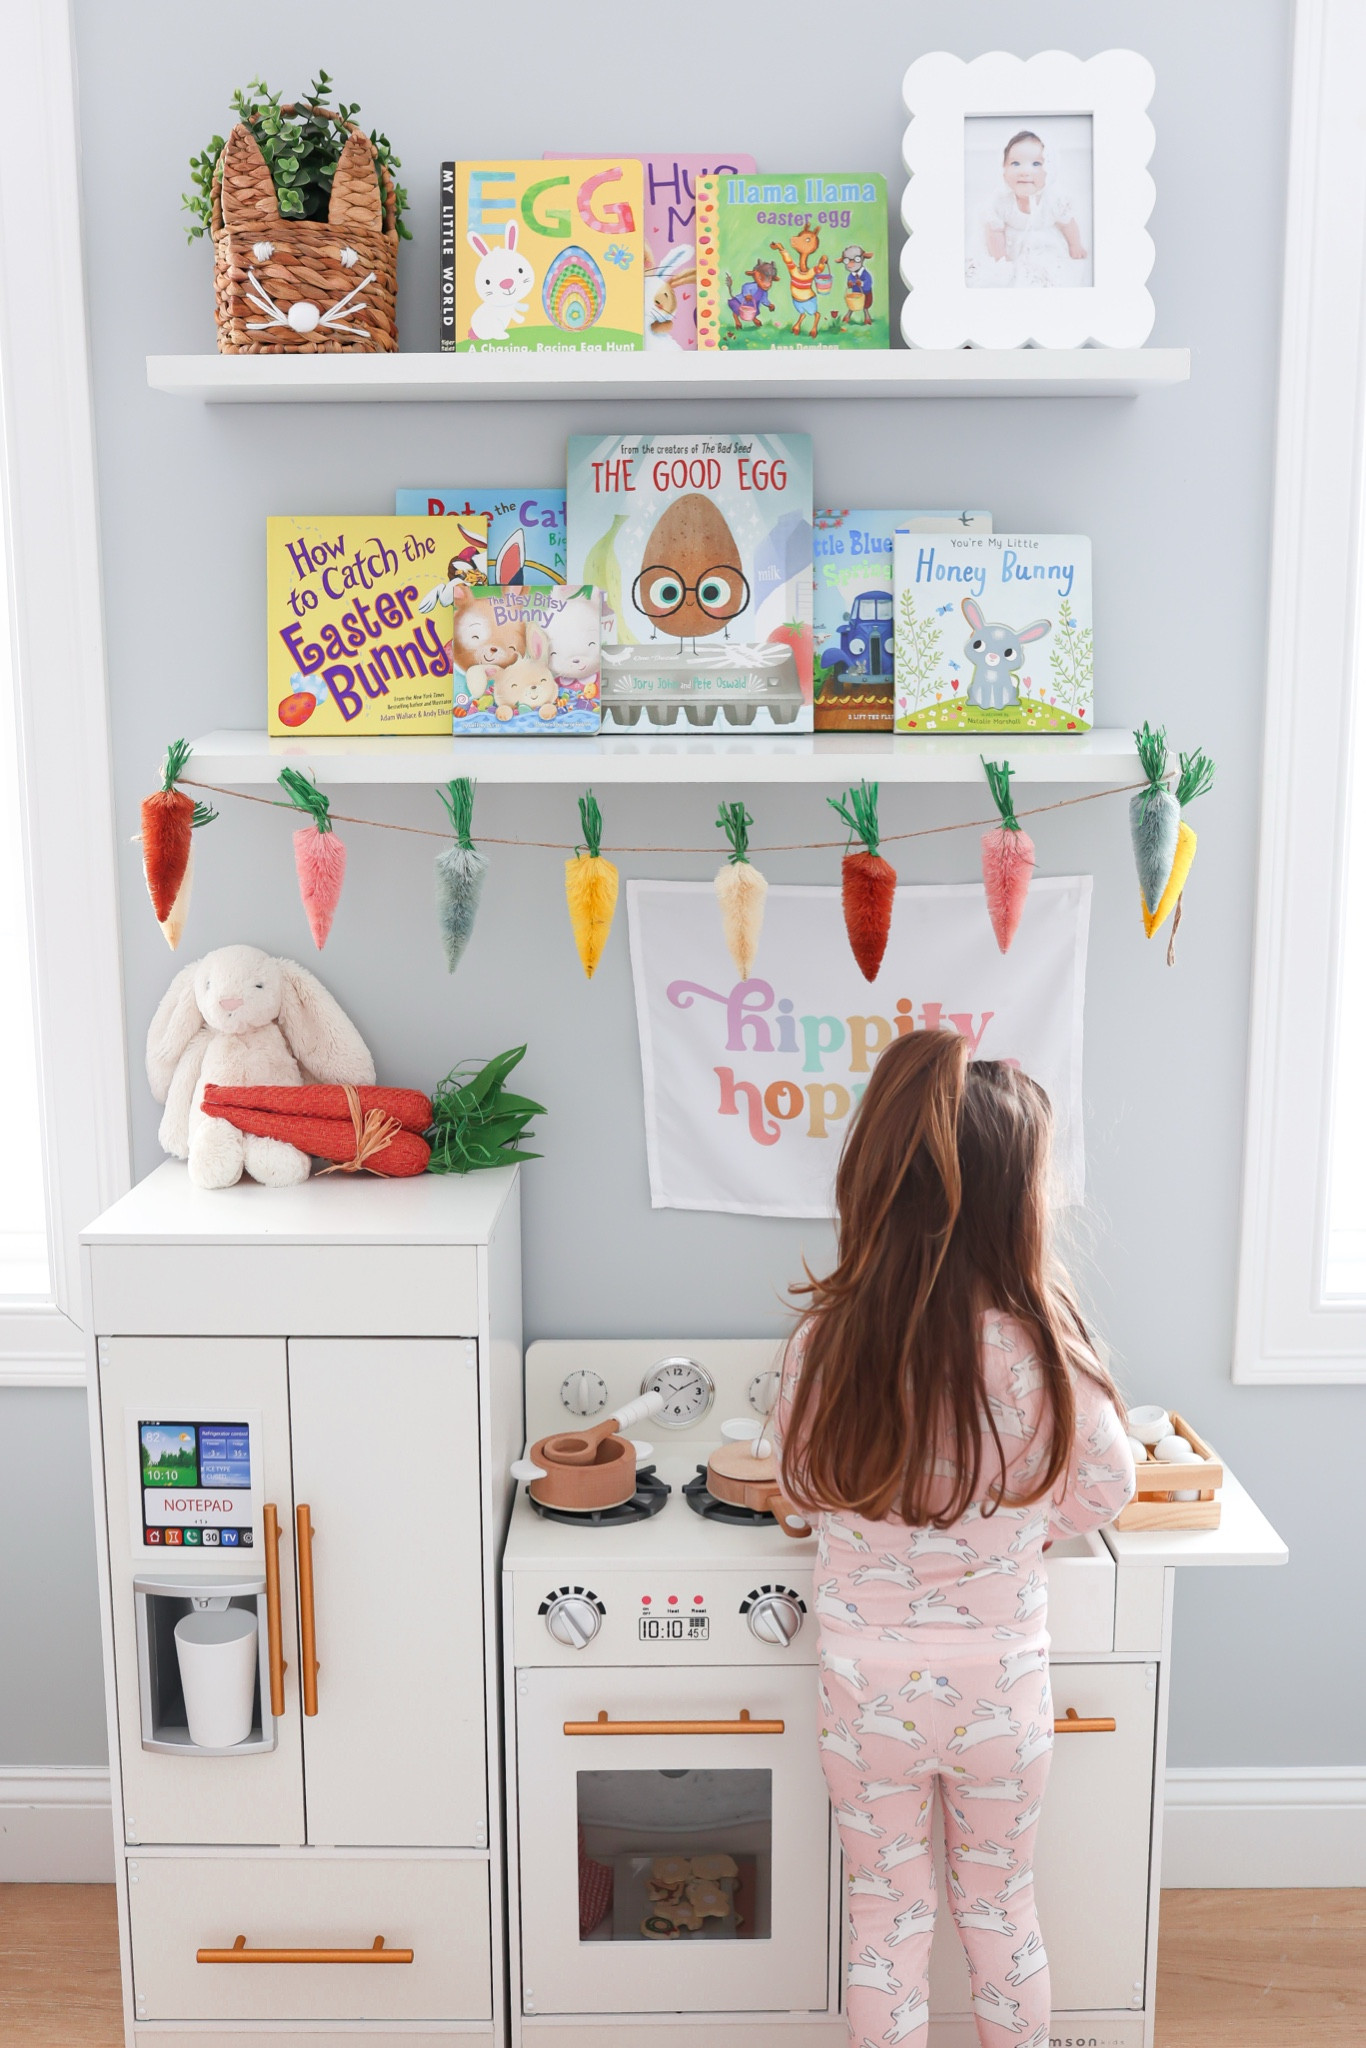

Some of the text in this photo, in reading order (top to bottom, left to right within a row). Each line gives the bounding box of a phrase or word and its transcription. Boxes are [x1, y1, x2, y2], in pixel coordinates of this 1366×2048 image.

[648, 162, 738, 205] HU
[727, 178, 877, 204] llama llama
[467, 167, 636, 238] EGG
[757, 210, 851, 228] easter egg
[442, 170, 454, 326] MY LITTLE WORLD
[469, 344, 476, 352] A
[606, 342, 635, 352] Hunt
[621, 443, 753, 455] From the creators of The Bad Seed
[592, 459, 788, 493] THE GOOD EGG
[494, 502, 517, 516] the
[813, 530, 893, 557] ttle Blue
[950, 538, 1039, 550] You're My Little
[285, 535, 346, 581] How
[287, 534, 436, 617] to Catch the
[758, 565, 782, 582] milk
[916, 548, 1074, 598] Honey Bunny
[505, 593, 531, 608] Itsy
[533, 592, 568, 614] Bitsy
[493, 606, 555, 629] Bunny
[279, 585, 419, 677] Easter
[321, 618, 452, 723] Bunny
[658, 678, 679, 689] John
[680, 681, 692, 689] and
[693, 677, 712, 689] Pete
[716, 677, 747, 689] Oswald
[696, 1387, 702, 1395] 3
[674, 1406, 681, 1414] 6
[148, 1470, 178, 1481] 10:10
[164, 1499, 233, 1512] NOTEPAD
[206, 1533, 217, 1542] 30
[224, 1534, 237, 1542] TV
[643, 1620, 682, 1638] 10:10
[688, 1628, 699, 1638] 45
[1049, 2038, 1097, 2047] mson
